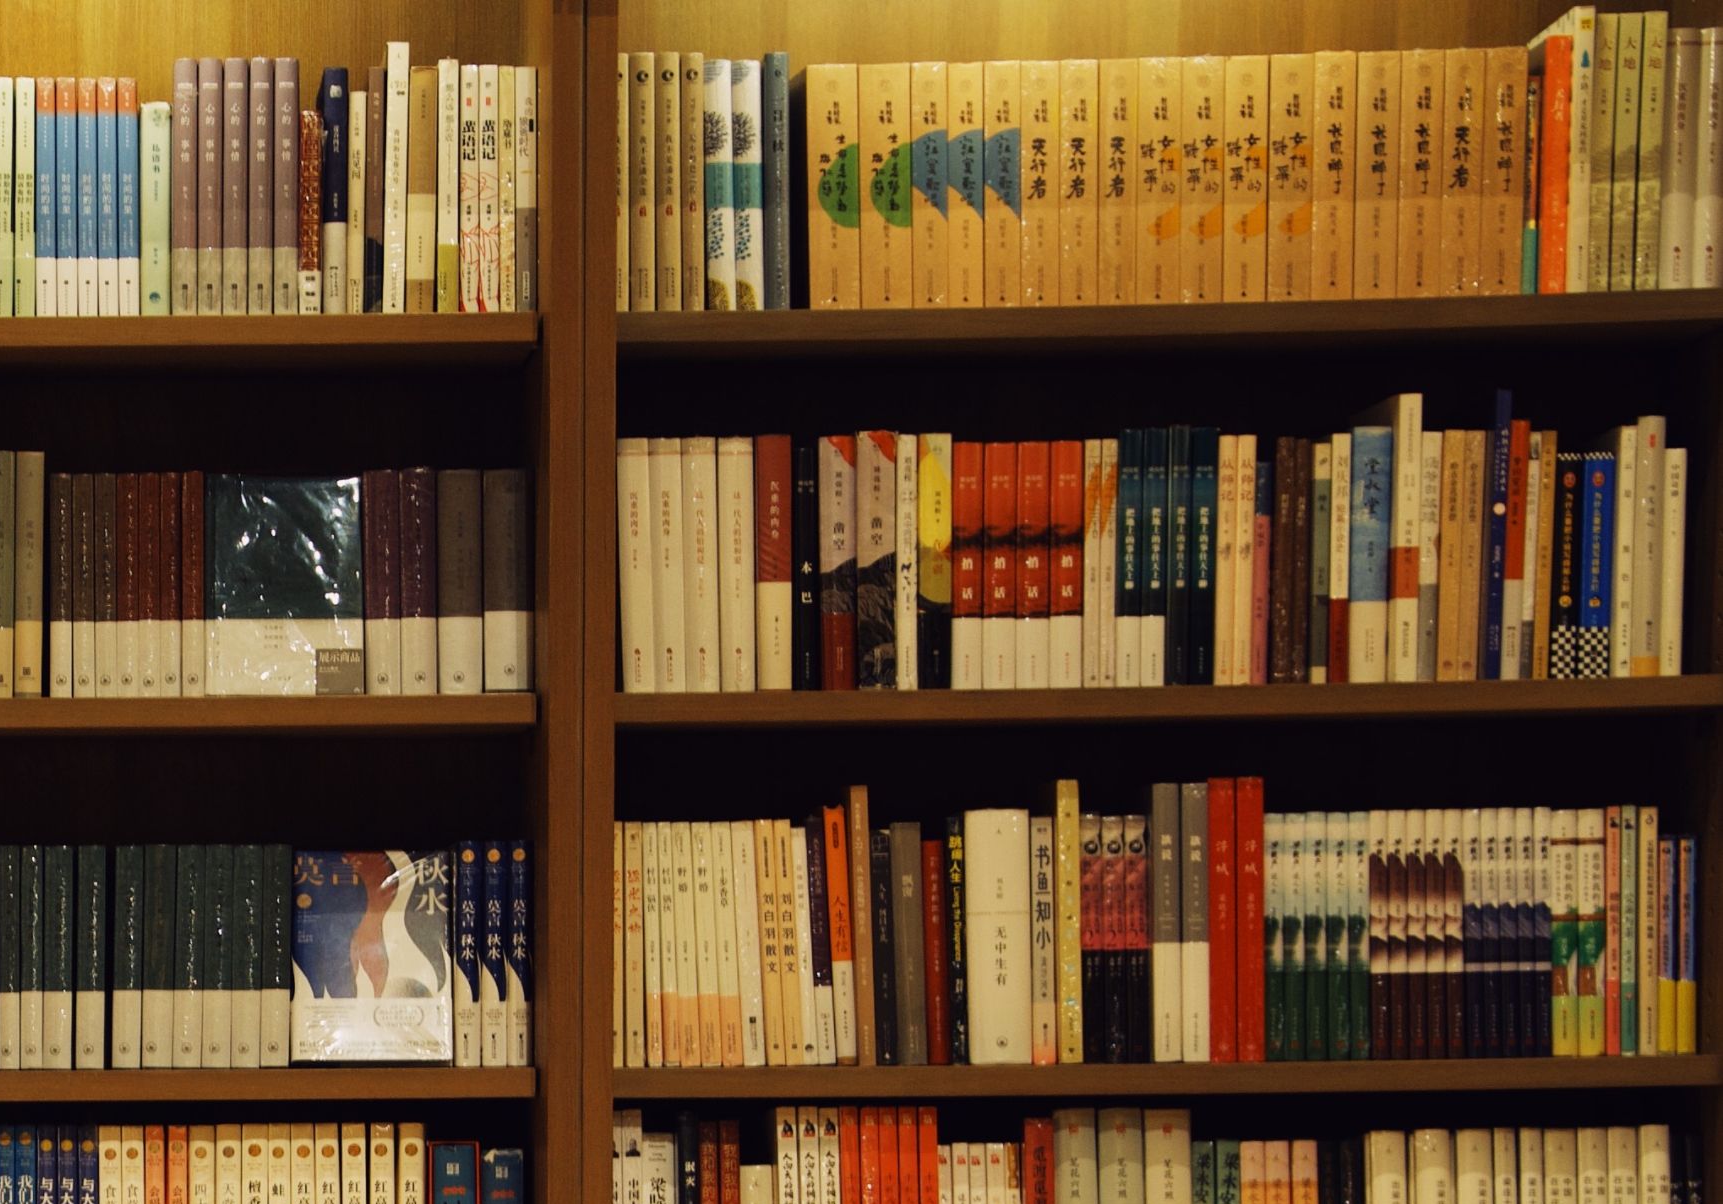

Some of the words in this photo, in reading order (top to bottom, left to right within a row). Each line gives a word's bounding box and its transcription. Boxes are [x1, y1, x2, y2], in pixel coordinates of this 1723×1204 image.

[1599, 37, 1612, 71] 大地
[1029, 137, 1048, 201] 天行者
[1067, 136, 1086, 200] 天行者
[1106, 135, 1125, 199] 天行者
[833, 522, 846, 550] 凿空
[800, 561, 814, 604] 本巴
[294, 854, 364, 886] 莫言
[416, 856, 449, 915] 秋水
[1035, 845, 1051, 948] 书鱼知小
[763, 893, 777, 973] 刘白羽散文
[782, 893, 797, 973] 刘白羽散文
[835, 897, 848, 952] 人生有信
[995, 925, 1008, 986] 无中生有
[271, 1182, 285, 1198] 蛙
